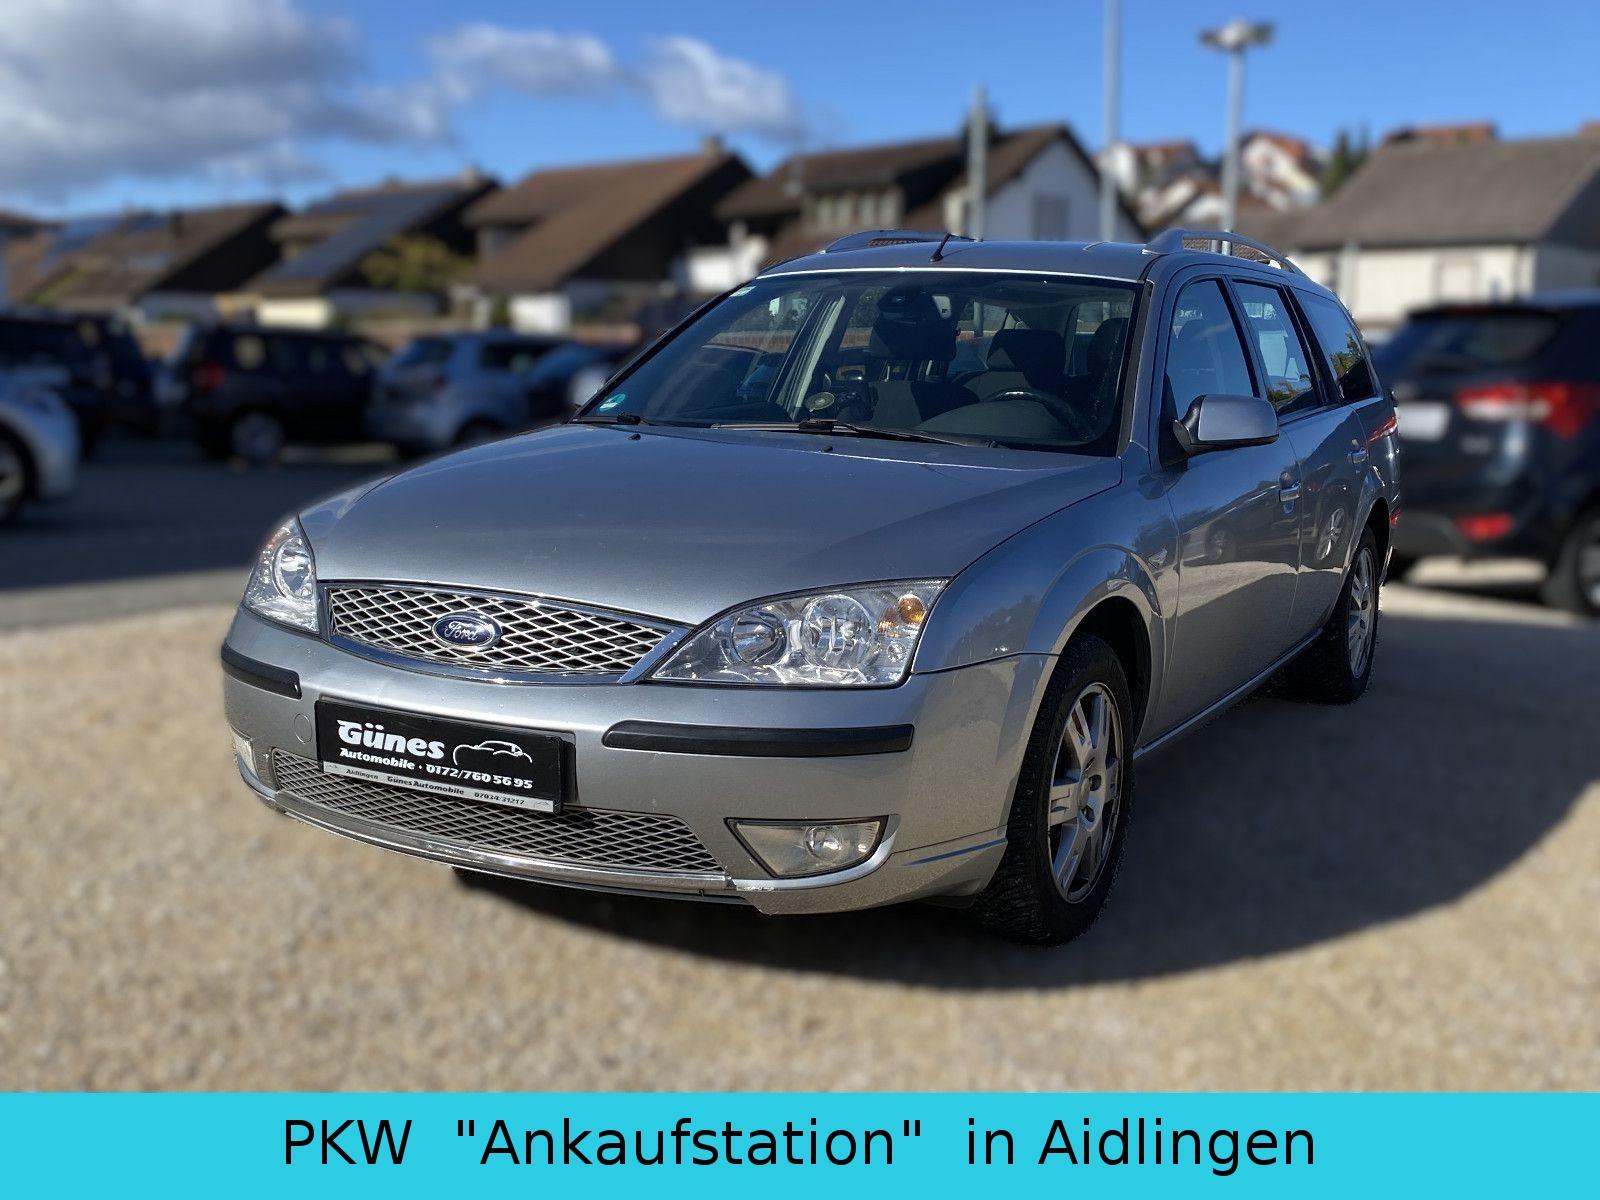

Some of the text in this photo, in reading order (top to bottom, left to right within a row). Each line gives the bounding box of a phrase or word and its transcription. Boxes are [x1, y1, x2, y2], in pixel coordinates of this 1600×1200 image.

[444, 621, 484, 641] Ford
[336, 719, 445, 759] Günes
[340, 747, 416, 770] Automobile
[492, 774, 512, 786] 56
